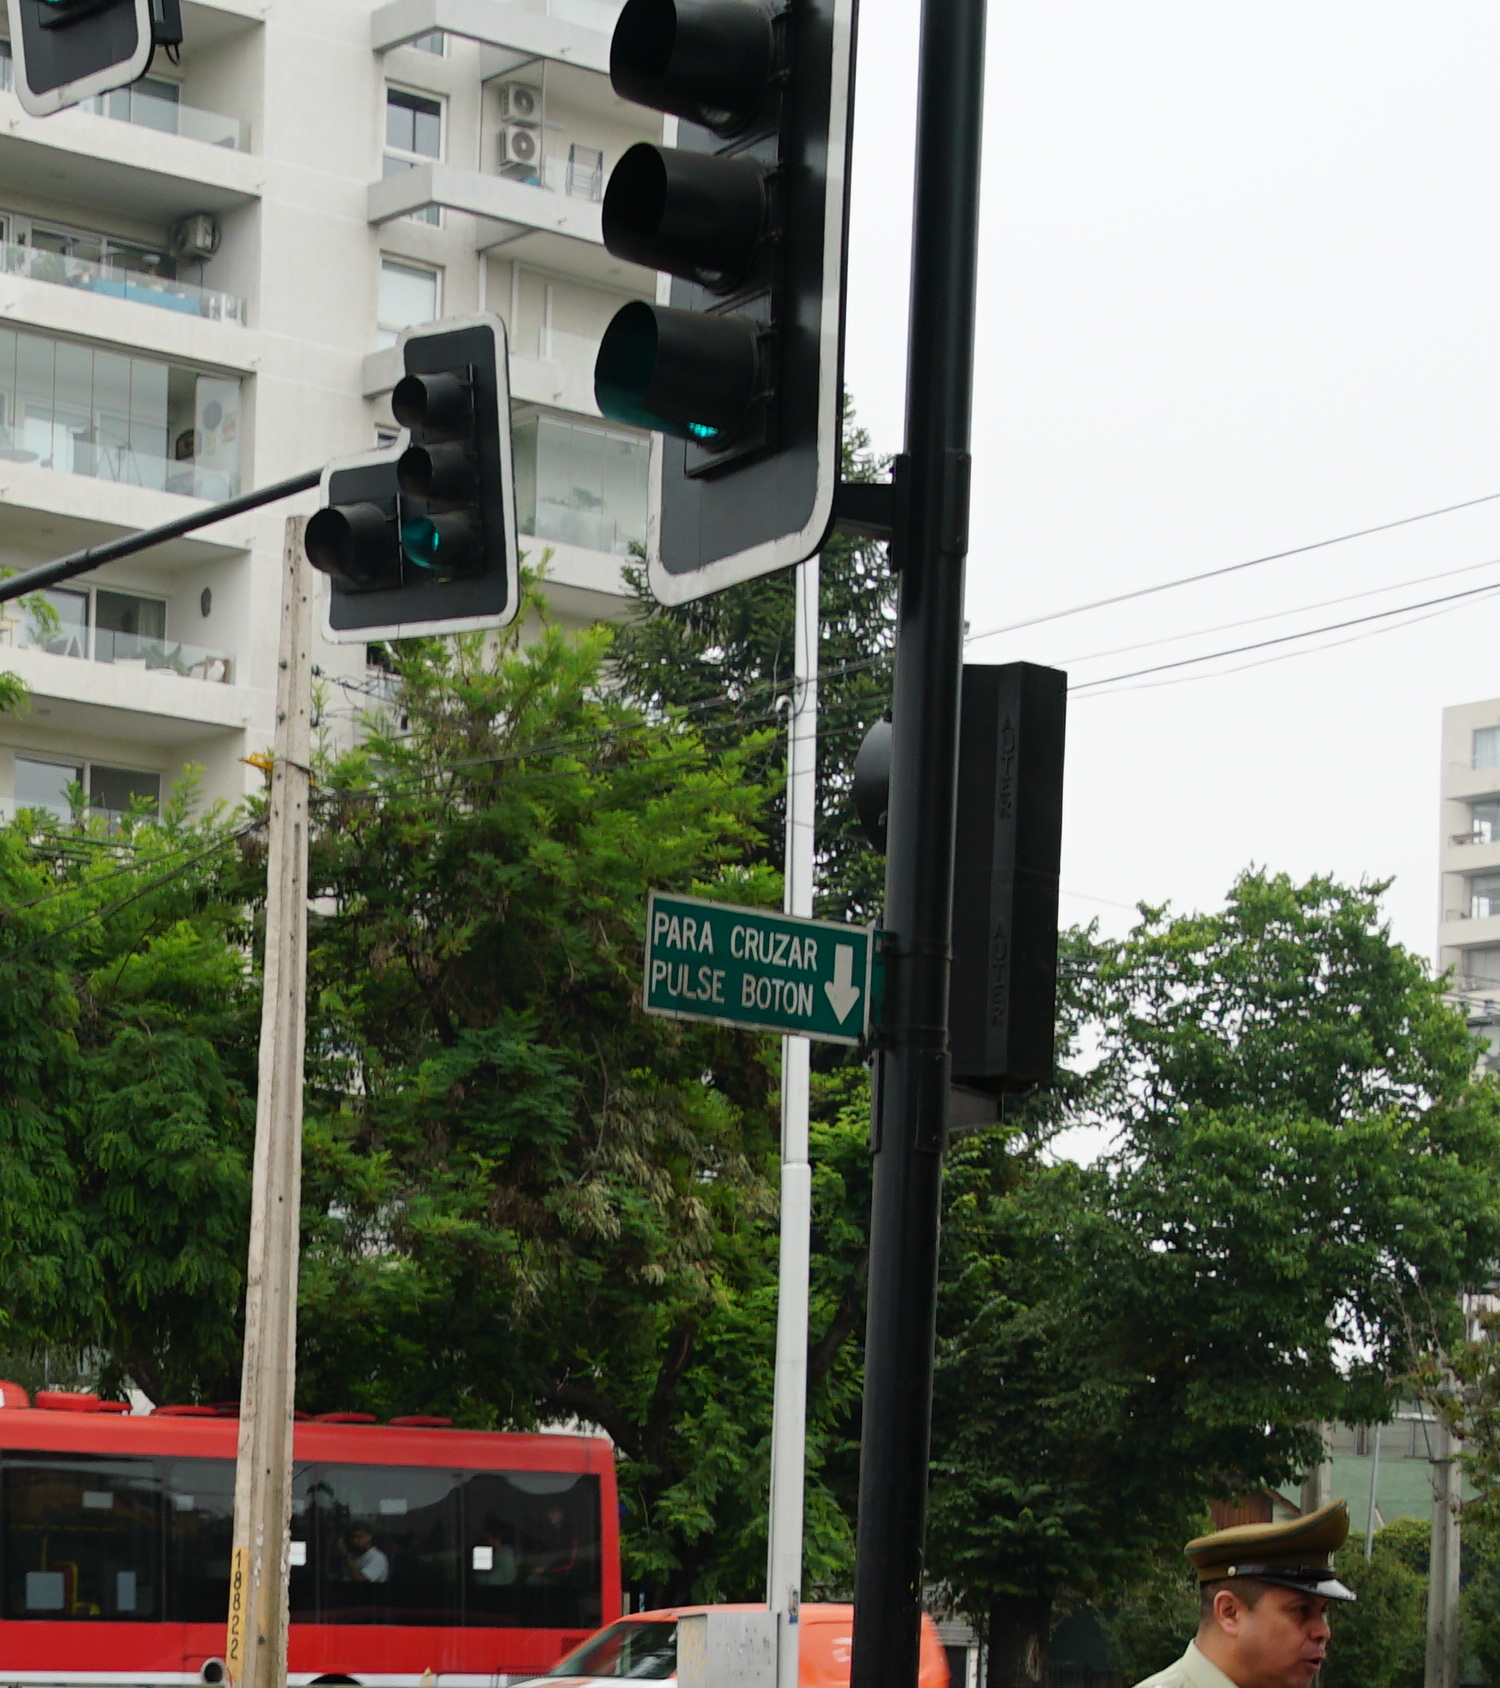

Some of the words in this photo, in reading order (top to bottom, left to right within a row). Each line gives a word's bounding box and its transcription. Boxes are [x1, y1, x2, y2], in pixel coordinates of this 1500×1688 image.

[654, 911, 714, 955] PARA
[730, 925, 818, 972] CRUZAR
[651, 960, 726, 1003] PULSE
[741, 973, 814, 1018] BOTON
[229, 1549, 242, 1661] 18822
